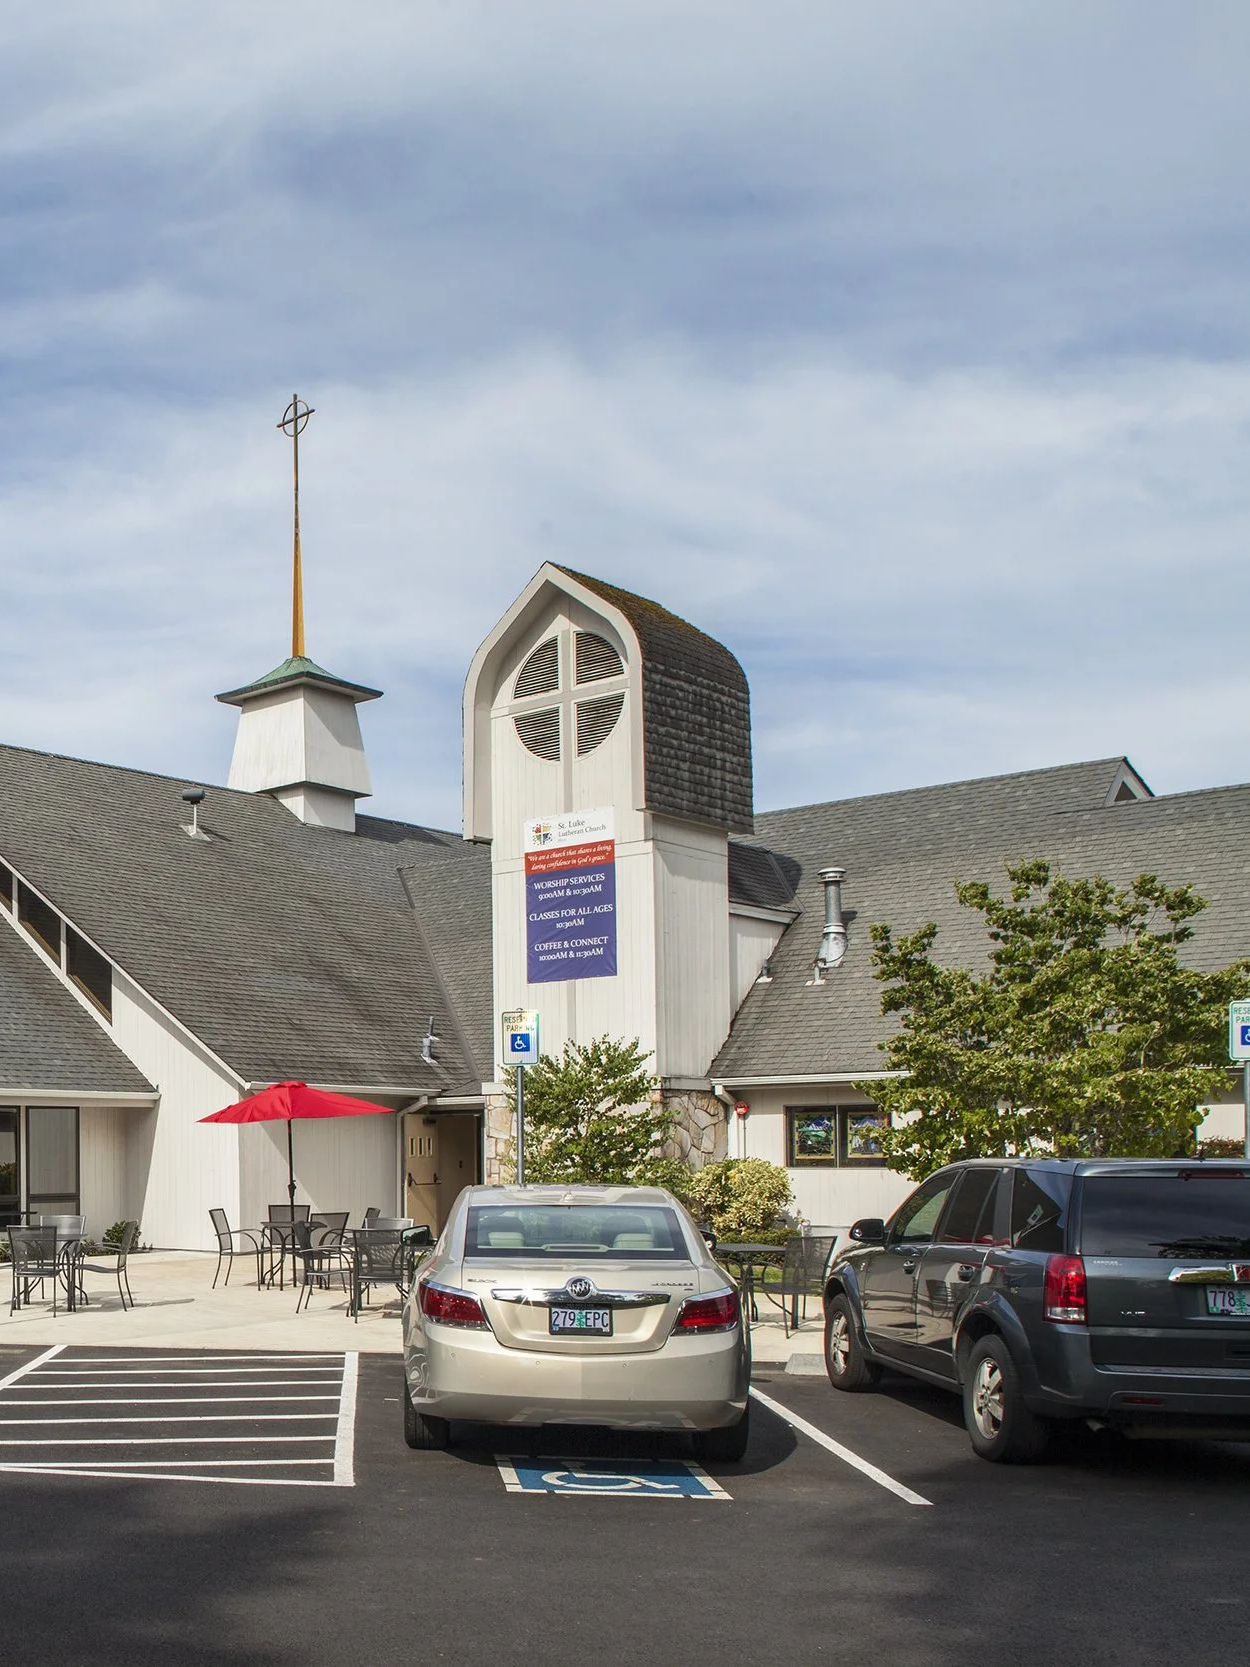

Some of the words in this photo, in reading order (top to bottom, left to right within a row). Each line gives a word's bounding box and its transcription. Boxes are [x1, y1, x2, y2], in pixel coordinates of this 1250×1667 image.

[558, 828, 584, 838] Lutheran
[584, 824, 606, 834] Church
[568, 820, 585, 828] Luke
[546, 859, 571, 870] confidence
[577, 856, 592, 864] God's
[533, 878, 569, 890] WORSHIP
[570, 872, 606, 885] SERVICES
[538, 889, 565, 902] 9:00AM
[566, 888, 572, 896] &
[572, 884, 602, 896] 10:30AM
[529, 910, 560, 922] CLASSES
[560, 908, 576, 918] FOR
[576, 907, 592, 916] ALL
[592, 903, 614, 913] AGES
[556, 918, 585, 929] 10:30AM
[534, 940, 563, 952] COFFEE
[563, 940, 570, 948] &
[570, 936, 609, 947] CONNECT
[538, 951, 568, 962] 10:00AM
[568, 950, 575, 958] &
[576, 948, 604, 958] 11:30AM
[506, 1024, 535, 1032] PARN
[1209, 1290, 1236, 1307] 778
[552, 1310, 576, 1327] 279
[584, 1312, 609, 1328] EPC
